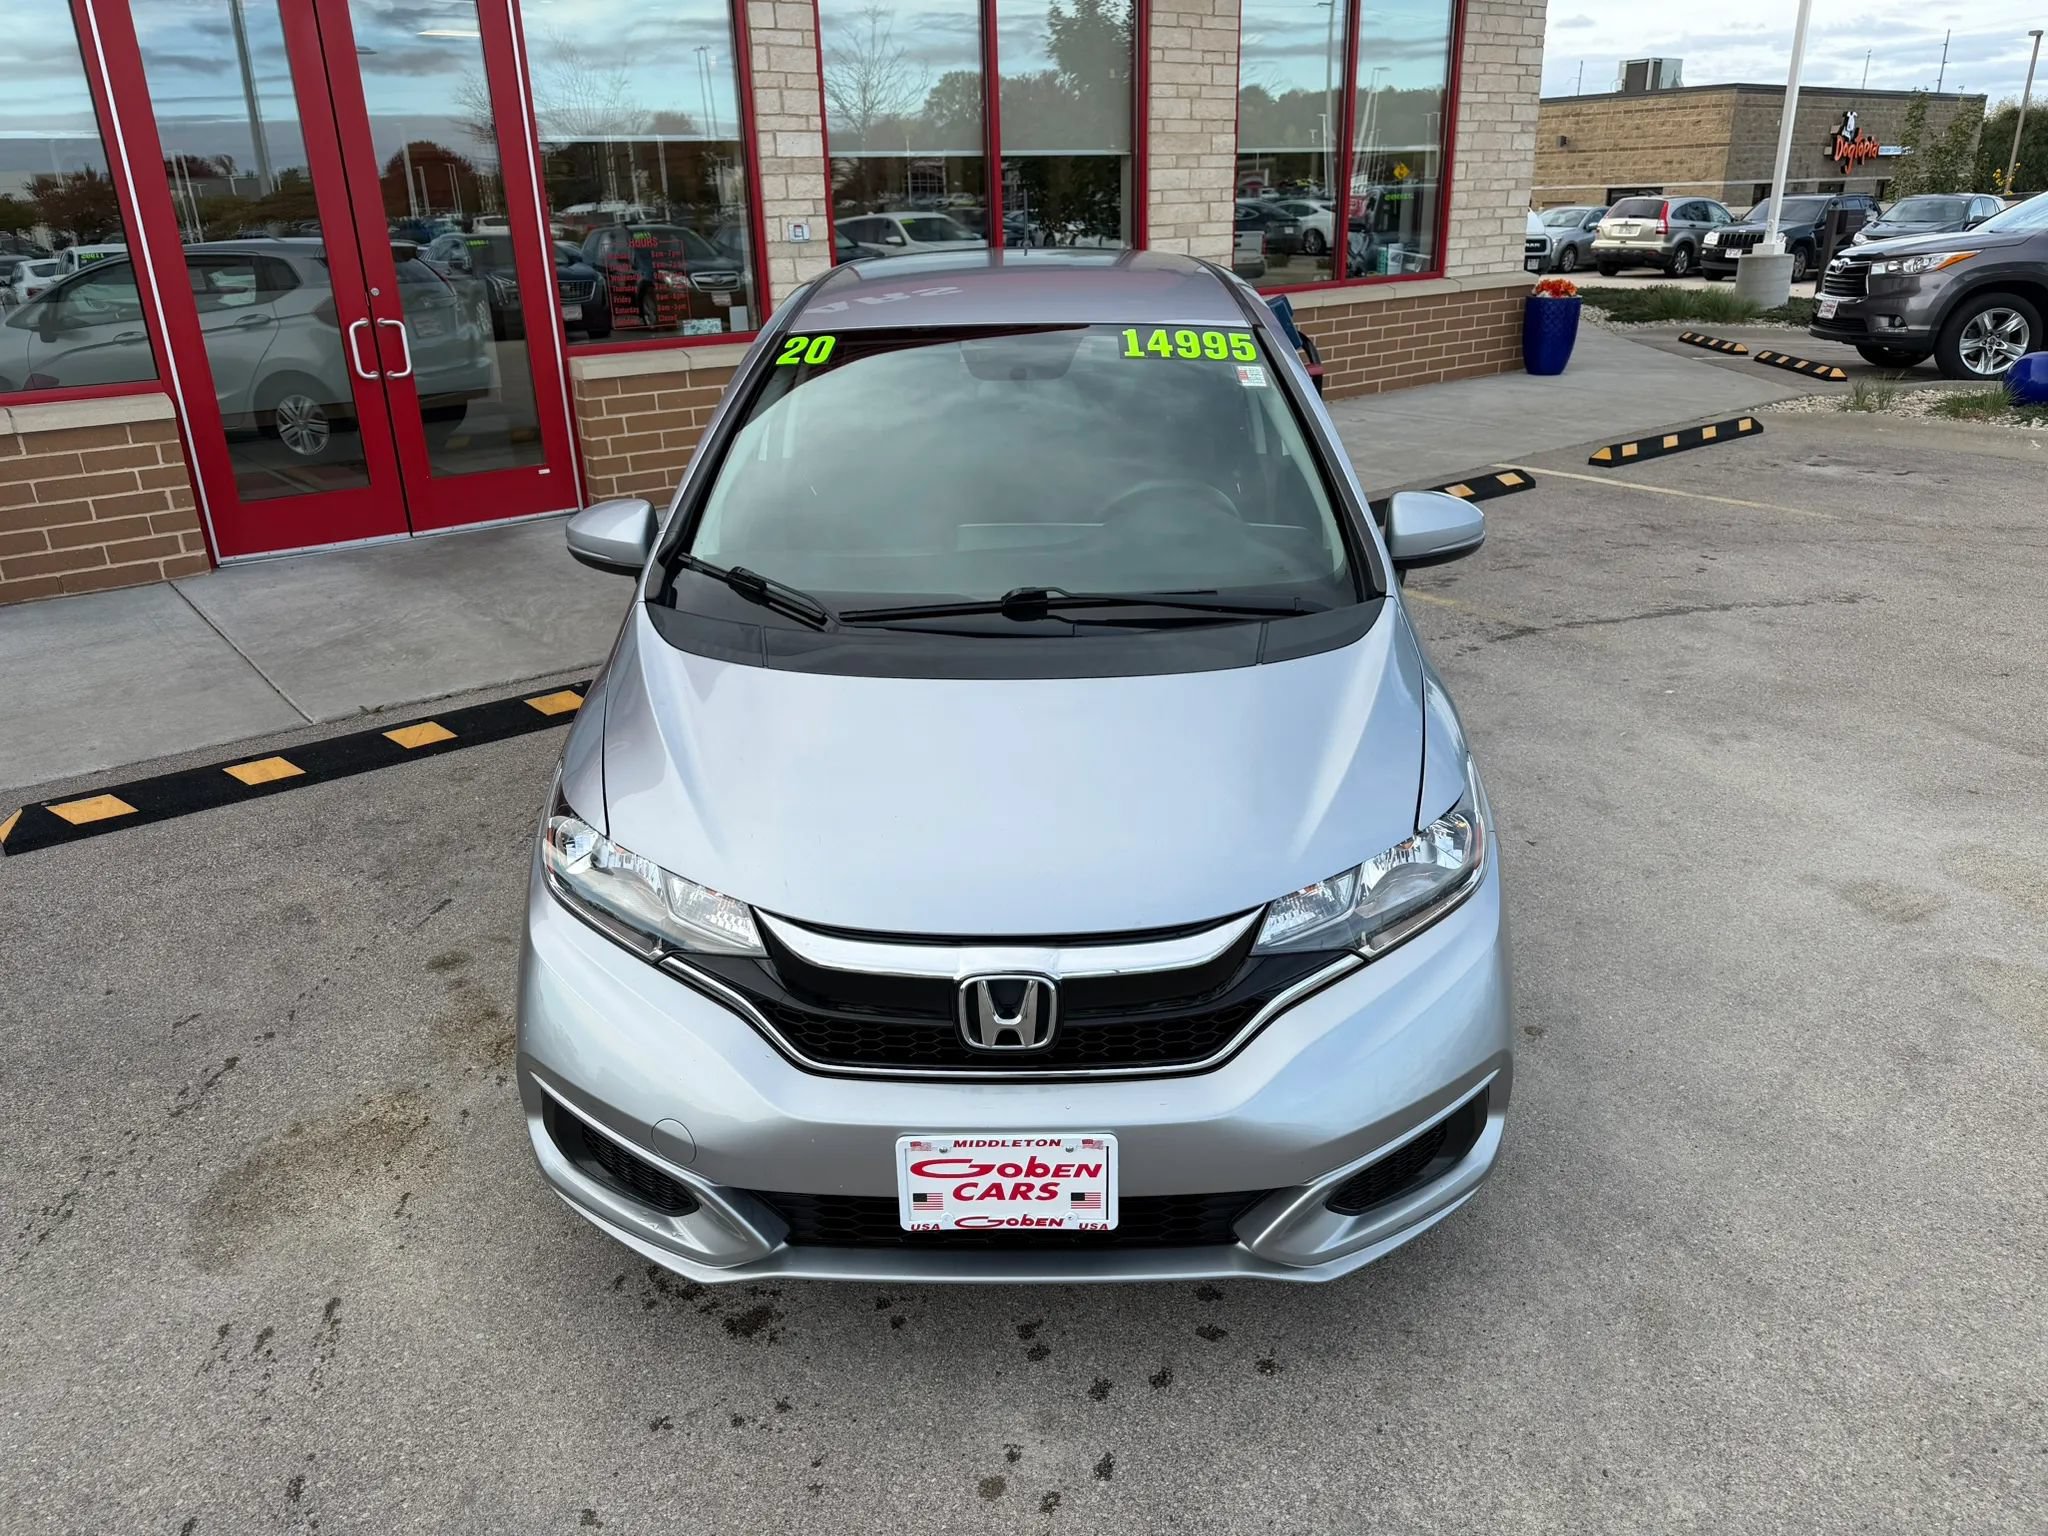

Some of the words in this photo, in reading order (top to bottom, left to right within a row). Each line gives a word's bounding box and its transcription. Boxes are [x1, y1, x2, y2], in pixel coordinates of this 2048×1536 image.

[1834, 128, 1880, 177] Dogtopia
[776, 336, 836, 364] 20
[1122, 329, 1257, 361] 14995
[953, 1139, 1062, 1148] MIDDLETON
[952, 1182, 1061, 1201] CARS
[910, 1223, 941, 1231] USA
[1078, 1222, 1109, 1230] USA
